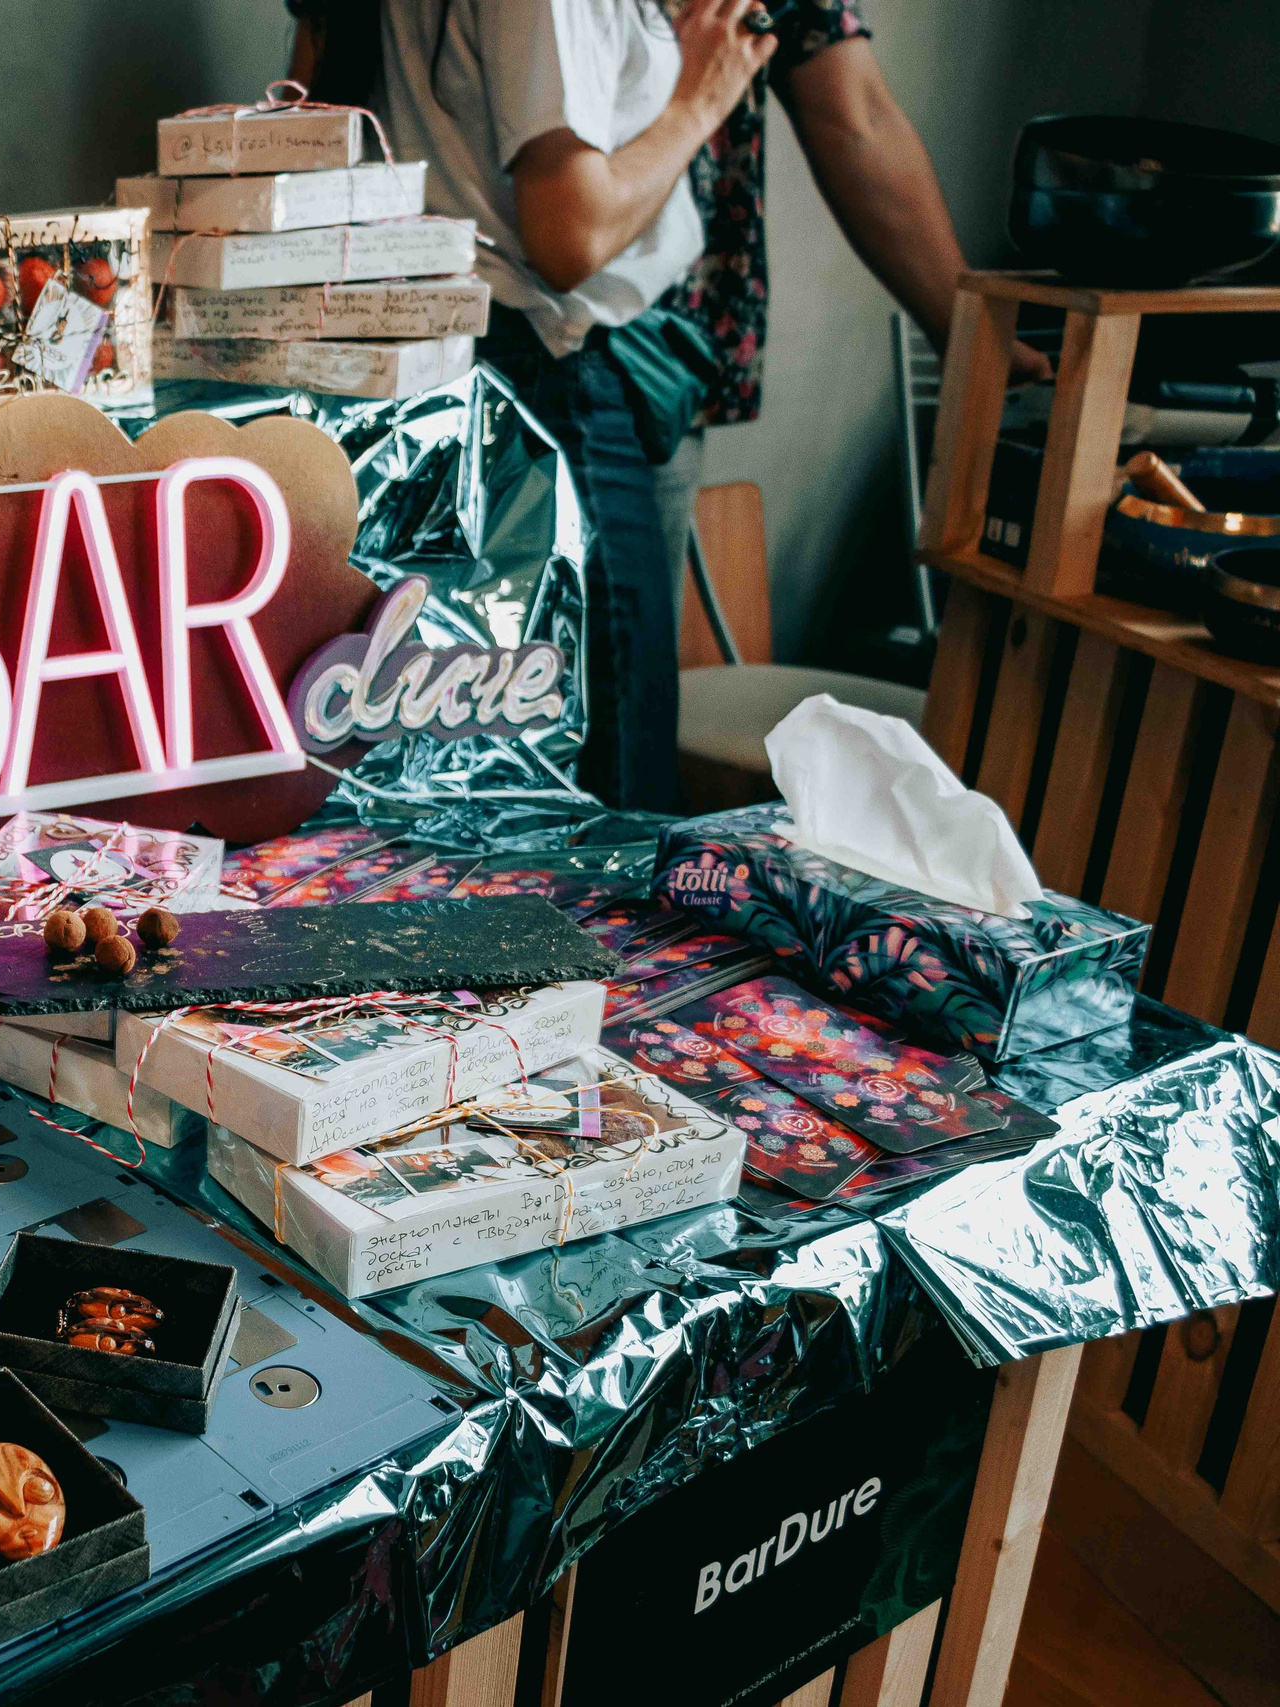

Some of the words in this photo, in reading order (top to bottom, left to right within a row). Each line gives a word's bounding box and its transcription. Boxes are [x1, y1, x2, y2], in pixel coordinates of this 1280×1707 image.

[675, 863, 729, 892] tolli
[682, 893, 723, 906] Classic
[358, 1096, 379, 1113] на
[387, 1072, 437, 1103] досках
[665, 1156, 697, 1174] стоя
[700, 1151, 723, 1166] на
[363, 1243, 434, 1267] досках
[452, 1237, 463, 1247] с
[365, 1258, 430, 1283] орбиты
[694, 1477, 881, 1615] BarDure
[796, 1631, 838, 1662] октября
